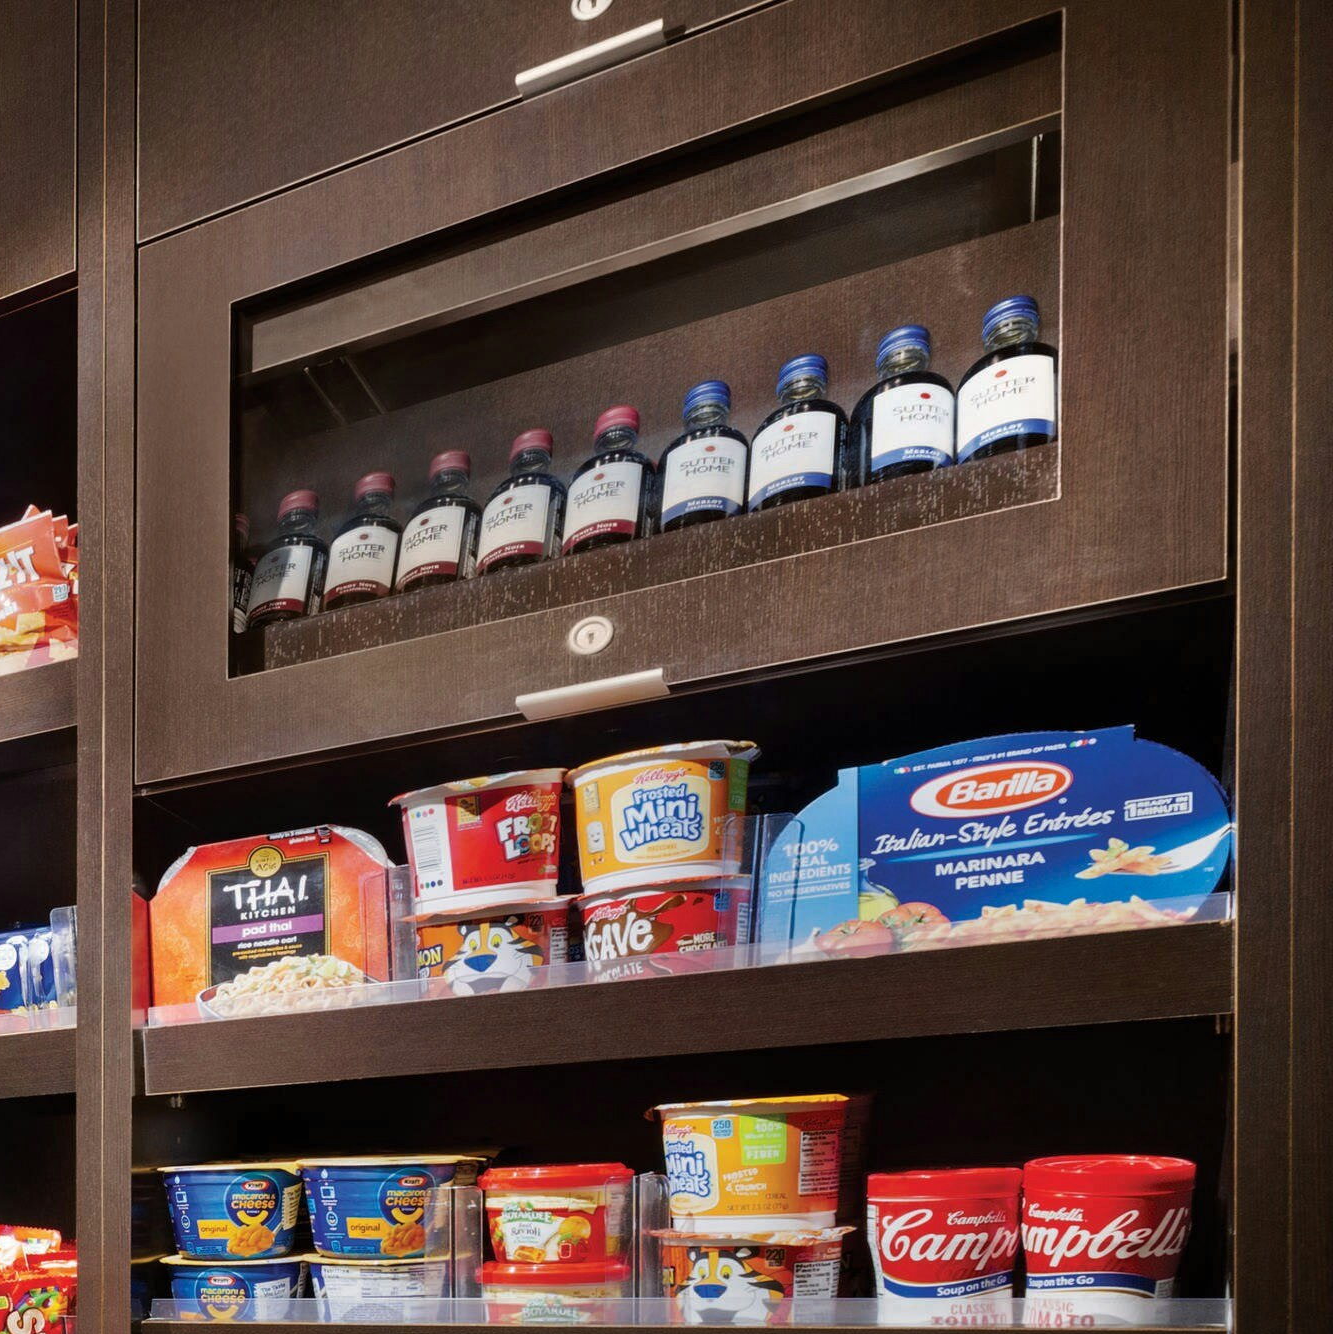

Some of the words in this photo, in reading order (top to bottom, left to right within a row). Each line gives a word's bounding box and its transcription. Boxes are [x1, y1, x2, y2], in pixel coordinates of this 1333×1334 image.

[633, 783, 687, 806] Frosted
[946, 770, 1058, 805] Barilla
[624, 794, 699, 828] Mini
[1137, 800, 1192, 818] MINUTE
[497, 813, 557, 843] FROOT
[618, 817, 704, 852] Wheats
[871, 813, 1020, 857] Italian-Style
[1023, 806, 1116, 835] Entrées
[503, 832, 557, 862] LOOPS
[781, 838, 839, 855] 100%
[791, 855, 829, 868] REAL
[935, 851, 1046, 877] MARINARA
[768, 863, 852, 884] INGREDIENTS
[954, 870, 1025, 890] PENNE
[222, 874, 309, 911] THAI
[240, 905, 297, 921] KITCHEN
[242, 924, 267, 938] pad
[269, 919, 293, 934] thai
[693, 931, 717, 944] MORE
[712, 1119, 732, 1130] 250
[745, 1148, 781, 1161] FIBER
[232, 1192, 271, 1201] macaroni
[199, 1224, 229, 1235] original
[349, 1222, 381, 1234] original
[937, 1285, 964, 1298] Soup
[966, 1284, 976, 1295] on
[979, 1279, 994, 1290] the
[995, 1274, 1008, 1287] Go
[1055, 1276, 1072, 1287] the
[1074, 1274, 1096, 1287] Go
[950, 1302, 997, 1315] CLASSIC
